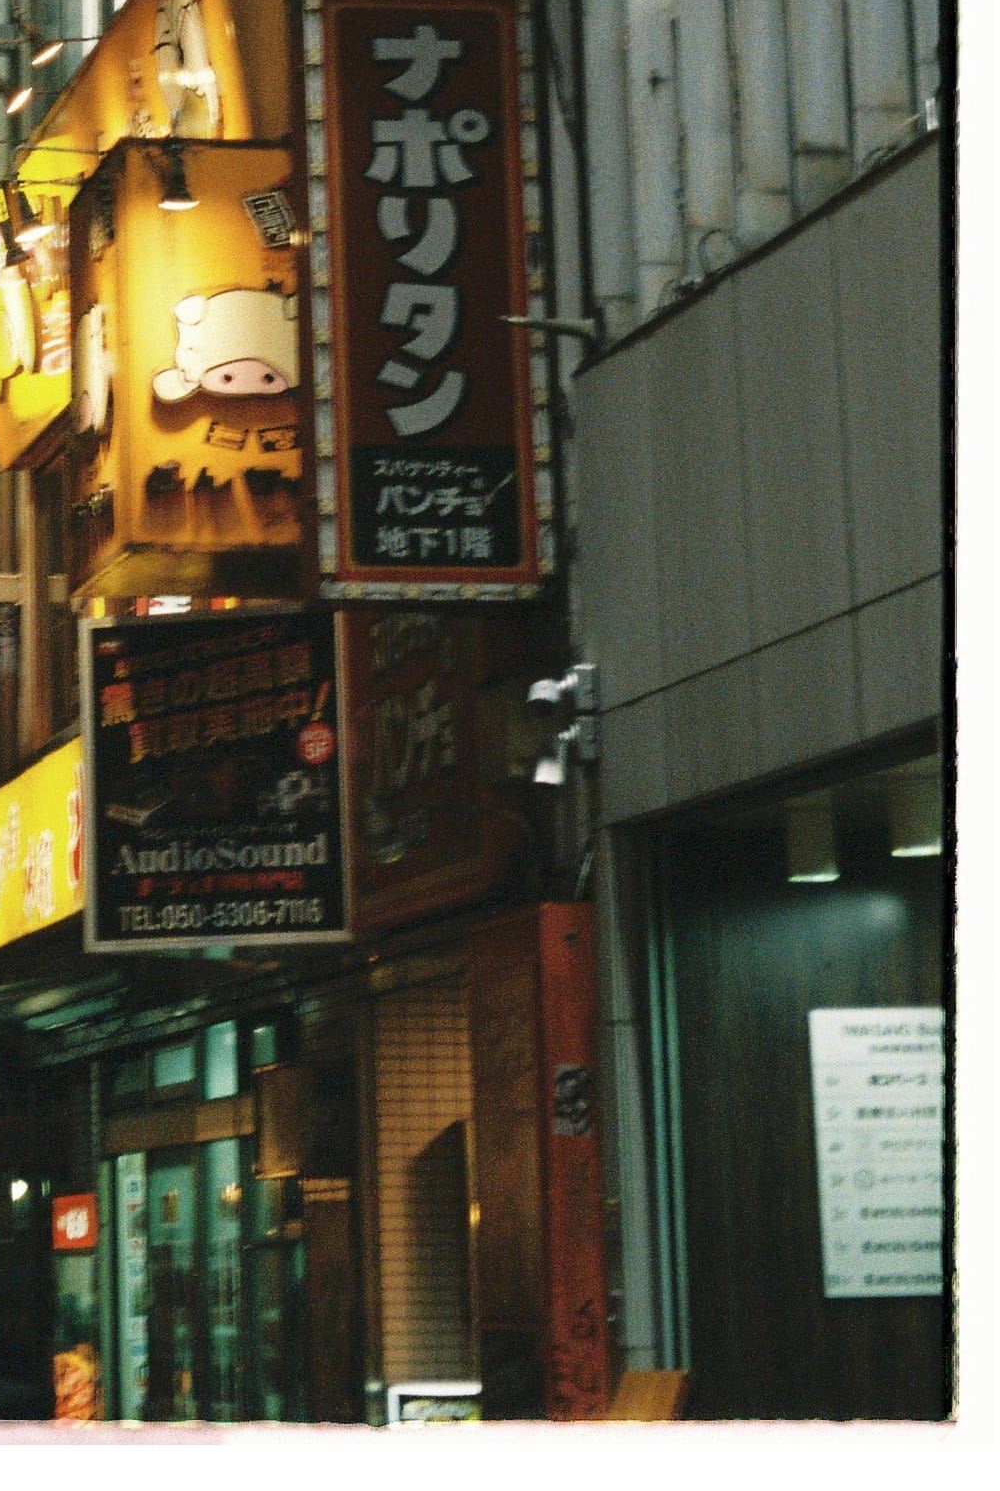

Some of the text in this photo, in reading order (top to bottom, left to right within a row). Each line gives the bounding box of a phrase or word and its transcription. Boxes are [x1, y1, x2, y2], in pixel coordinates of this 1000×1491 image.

[364, 24, 490, 436] ナポリタン
[111, 833, 329, 876] AudioSound
